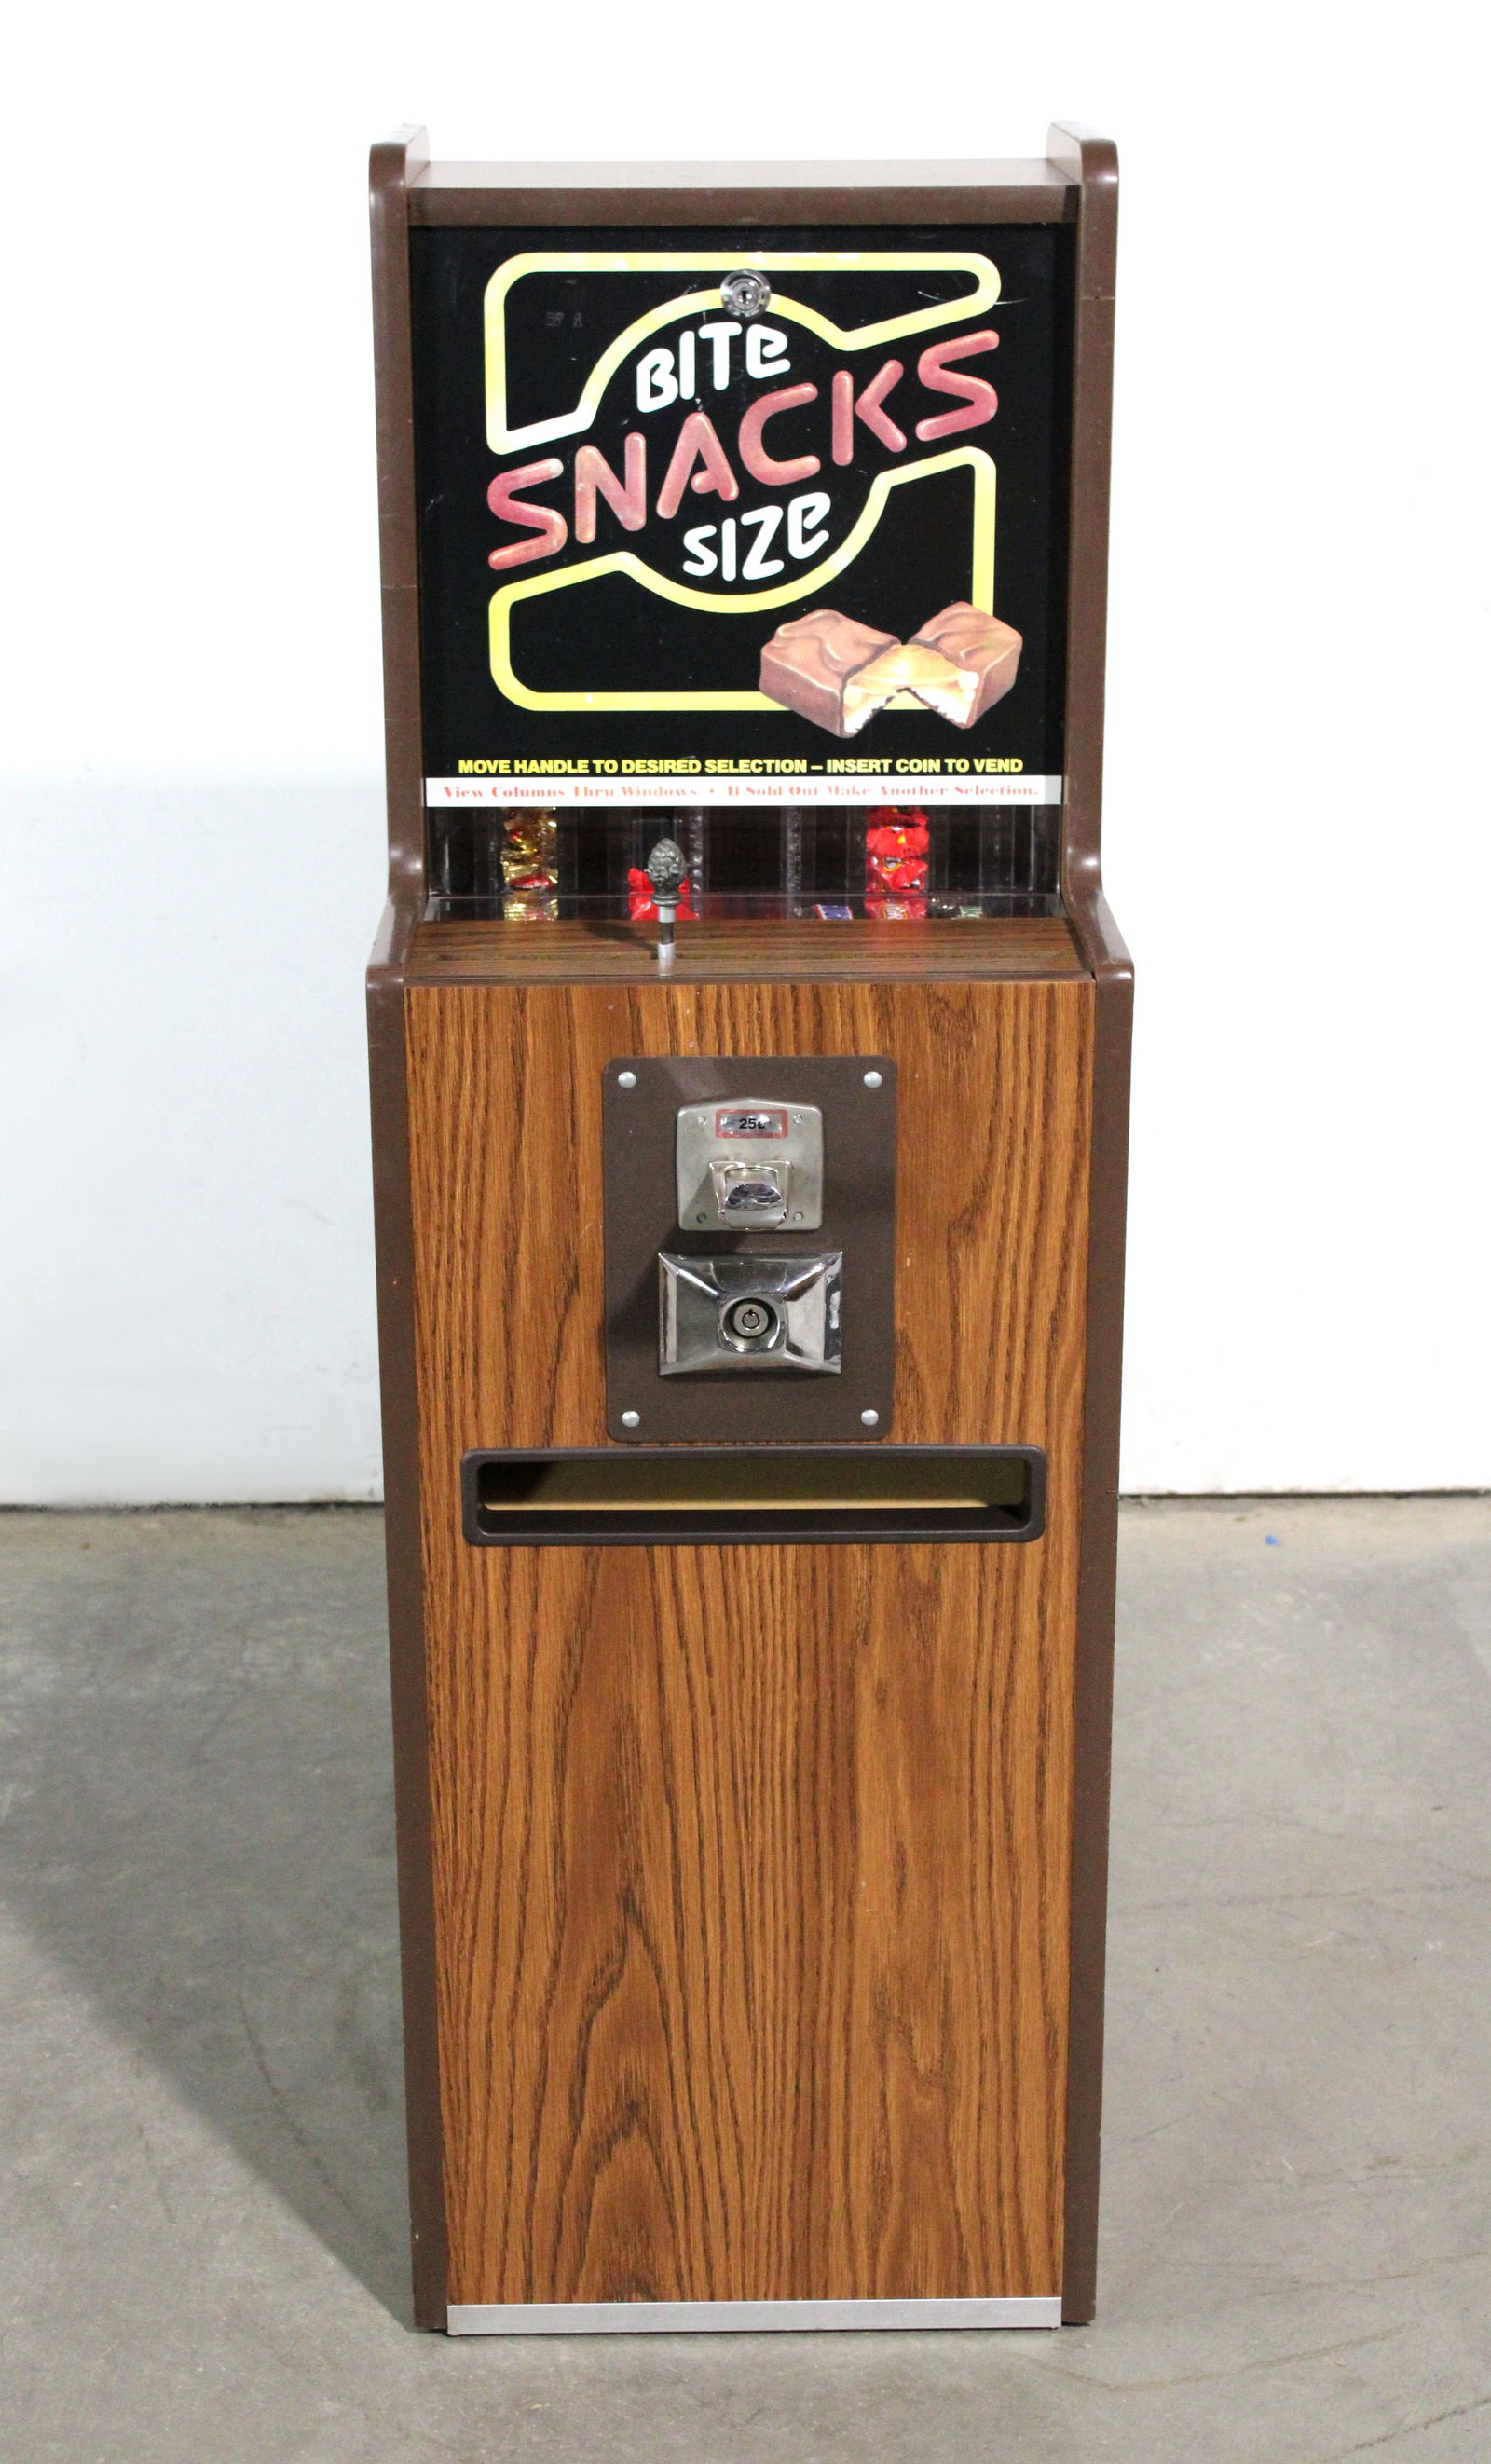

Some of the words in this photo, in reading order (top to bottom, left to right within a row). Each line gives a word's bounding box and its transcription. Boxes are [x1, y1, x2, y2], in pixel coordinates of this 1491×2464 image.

[486, 329, 1000, 571] SNACKS
[458, 760, 511, 774] MOVE
[514, 760, 589, 774] HANDLE
[593, 760, 618, 774] TO
[622, 760, 702, 774] DESIRED
[704, 759, 808, 773] SELECTION
[827, 759, 893, 773] INSERT
[896, 759, 941, 773] COIN
[944, 759, 970, 773] TO
[973, 759, 1024, 773] VEND
[443, 787, 484, 799] View
[491, 787, 566, 799] Columns
[572, 787, 615, 799] Thru
[746, 786, 783, 798] Sold
[788, 786, 820, 798] Out
[881, 785, 949, 797] Another
